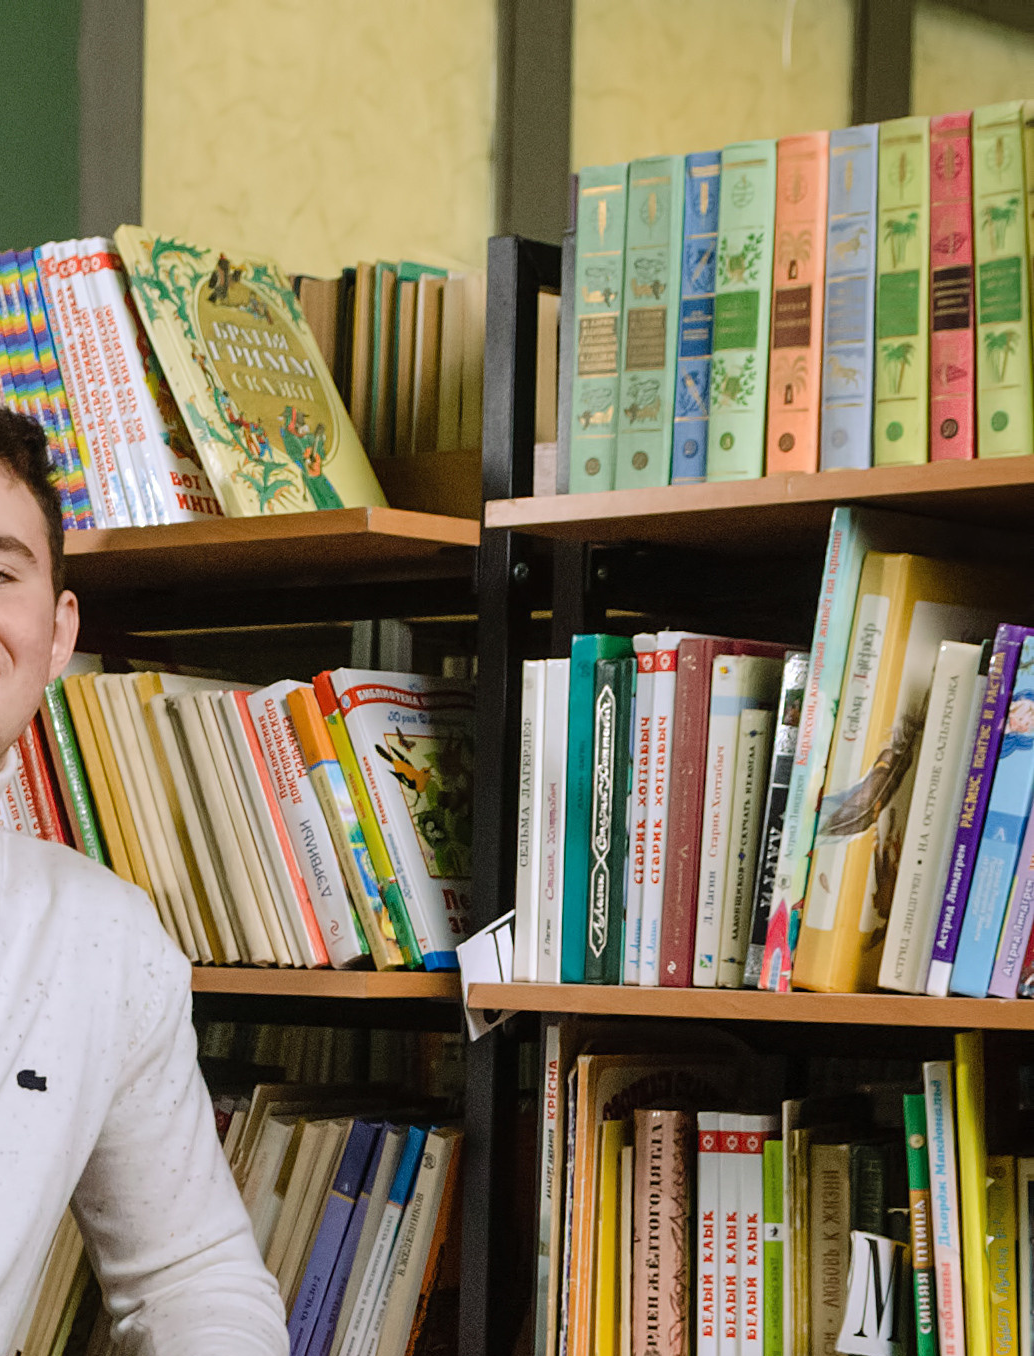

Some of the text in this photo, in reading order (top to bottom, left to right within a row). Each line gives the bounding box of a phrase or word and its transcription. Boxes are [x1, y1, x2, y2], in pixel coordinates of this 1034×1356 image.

[207, 340, 316, 380] ГРИММ
[231, 372, 315, 403] СКАЗКИ
[815, 597, 834, 639] живёт
[807, 640, 828, 698] который
[795, 699, 820, 767] Карлссон,
[519, 718, 532, 867] СЕЛЬМА ЛАГЕРЛЕФ
[633, 716, 650, 884] СТАРИК ХОТТАБЫЧ
[651, 715, 667, 884] СТАРИК ХОТТАБЫЧ
[707, 745, 726, 858] Старик Хоттабыч
[921, 766, 942, 828] ОСТРОВЕ
[917, 833, 930, 853] НА
[944, 843, 970, 904] Линдгрен
[705, 870, 717, 910] Лагин
[935, 905, 956, 951] Астрид
[999, 934, 1022, 978] Астрид
[699, 1210, 715, 1337] БЕЛЫЙ КЛЫК
[721, 1211, 738, 1338] БЕЛЫЙ КЛЫК
[742, 1213, 759, 1341] БЕЛЫЙ КЛЫК
[822, 1249, 839, 1309] ЛЮБОВЬ
[853, 1236, 904, 1347] М
[912, 1199, 933, 1334] СИНЯЯ ПТИЦА
